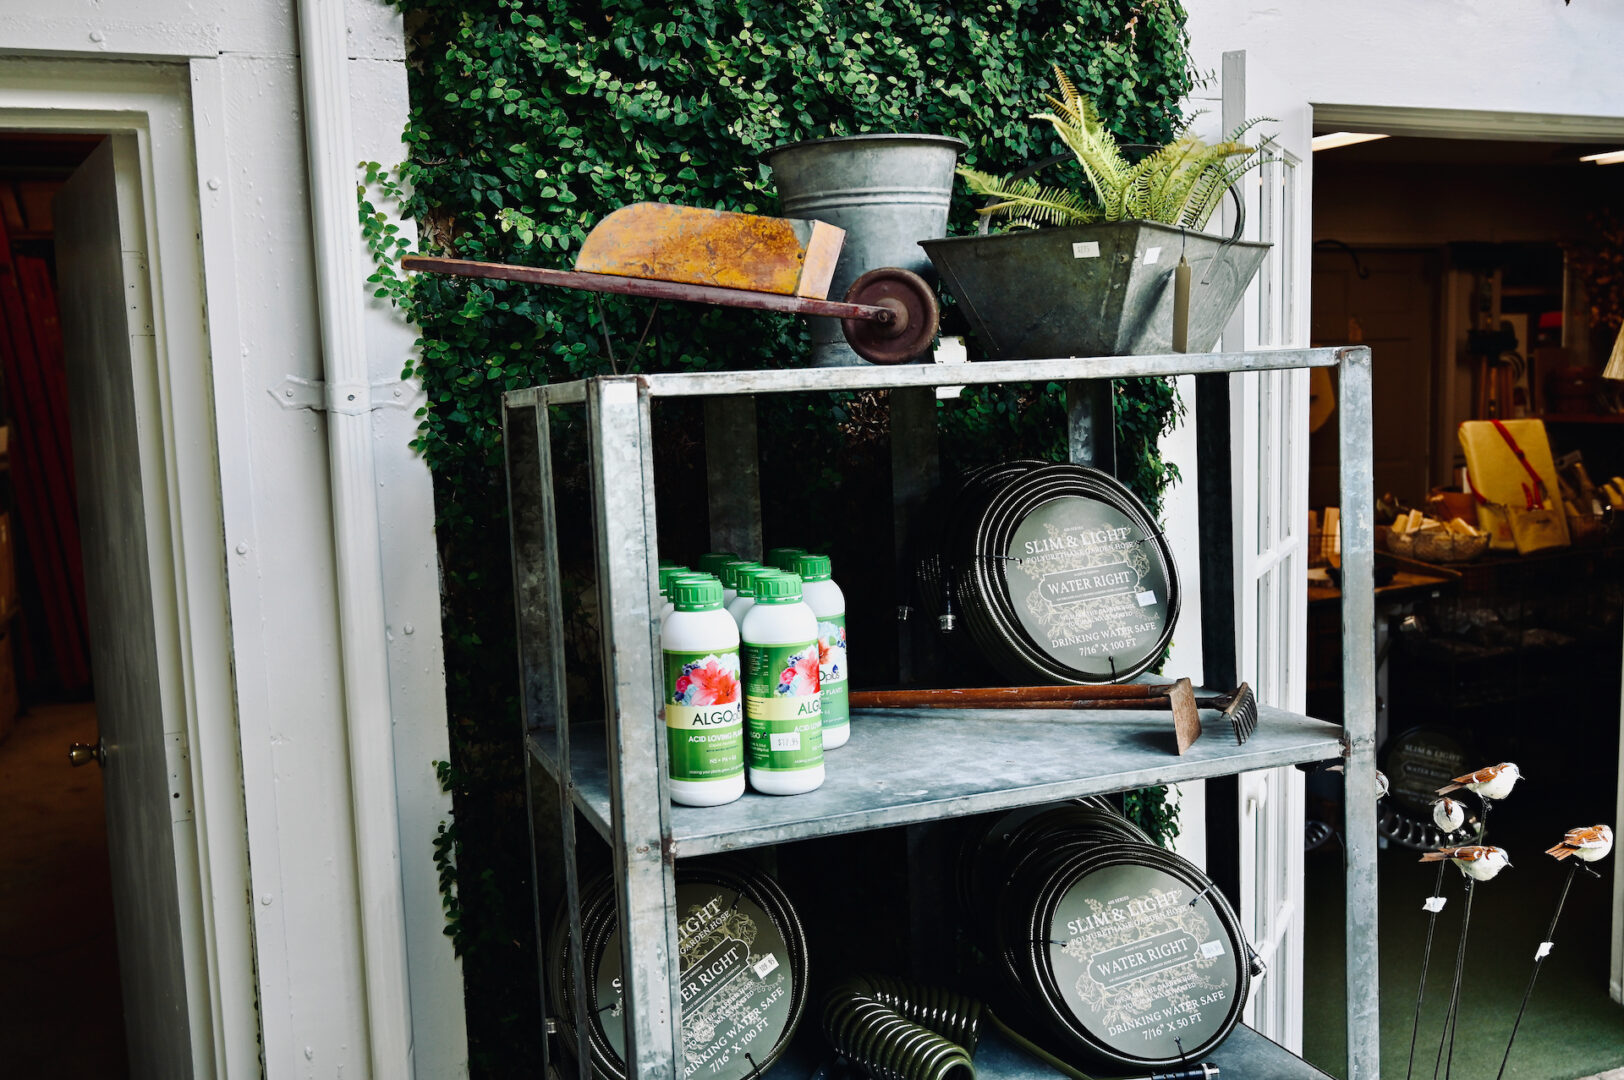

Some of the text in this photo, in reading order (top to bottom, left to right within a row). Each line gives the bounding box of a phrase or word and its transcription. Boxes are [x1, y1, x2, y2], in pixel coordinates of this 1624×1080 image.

[1025, 528, 1128, 554] SLIM & LIGHT
[1048, 579, 1092, 595] WATER
[1093, 571, 1130, 588] RIGHT
[1052, 622, 1157, 648] DRINKING WATER SAFE
[1110, 640, 1125, 650] 100
[1125, 638, 1137, 647] FT
[688, 735, 706, 743] ACID
[1067, 891, 1179, 935] SLIM & LIGHT
[680, 910, 730, 955] GARDEN HOSE
[1071, 920, 1133, 945] POLYURETHANE
[698, 947, 739, 987] RIGHT
[1097, 954, 1146, 976] WATER
[1147, 938, 1188, 963] RIGHT
[726, 1008, 762, 1039] WATER
[760, 986, 785, 1010] SAFE
[1108, 1011, 1161, 1036] DRINKING
[1162, 999, 1200, 1018] WATER
[1200, 990, 1226, 1006] SAFE
[1176, 1017, 1189, 1028] 50
[1189, 1012, 1202, 1024] FT
[740, 1029, 757, 1045] 100
[756, 1017, 769, 1033] FT
